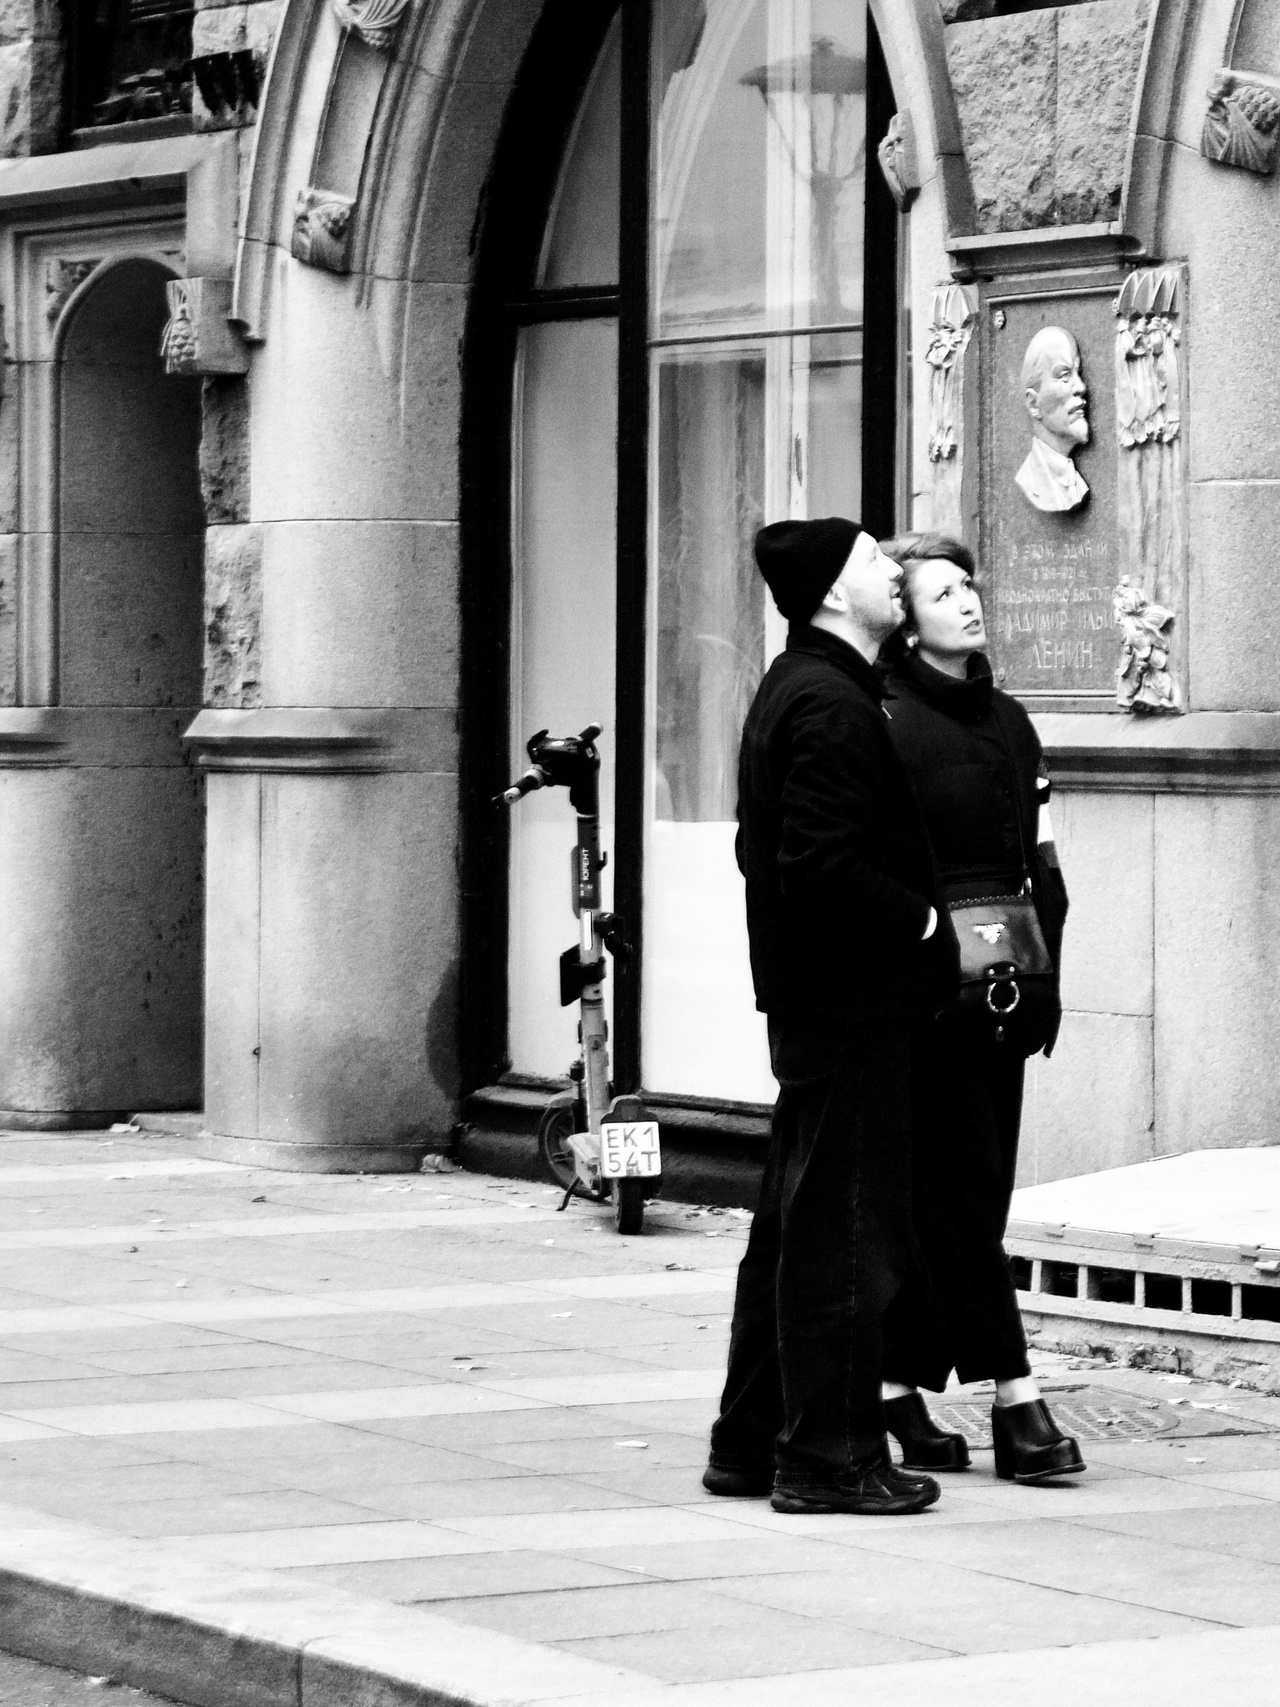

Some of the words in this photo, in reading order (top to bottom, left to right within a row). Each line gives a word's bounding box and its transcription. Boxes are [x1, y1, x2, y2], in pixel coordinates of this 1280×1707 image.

[1023, 542, 1054, 560] ЭТОМ
[1063, 541, 1109, 558] ЗДАНИИ
[995, 609, 1068, 632] ВЛАДИМИР
[1077, 608, 1115, 630] ИЛЬИ
[1027, 641, 1093, 668] ЛЕНИН
[581, 847, 590, 882] ЮРЕНТ
